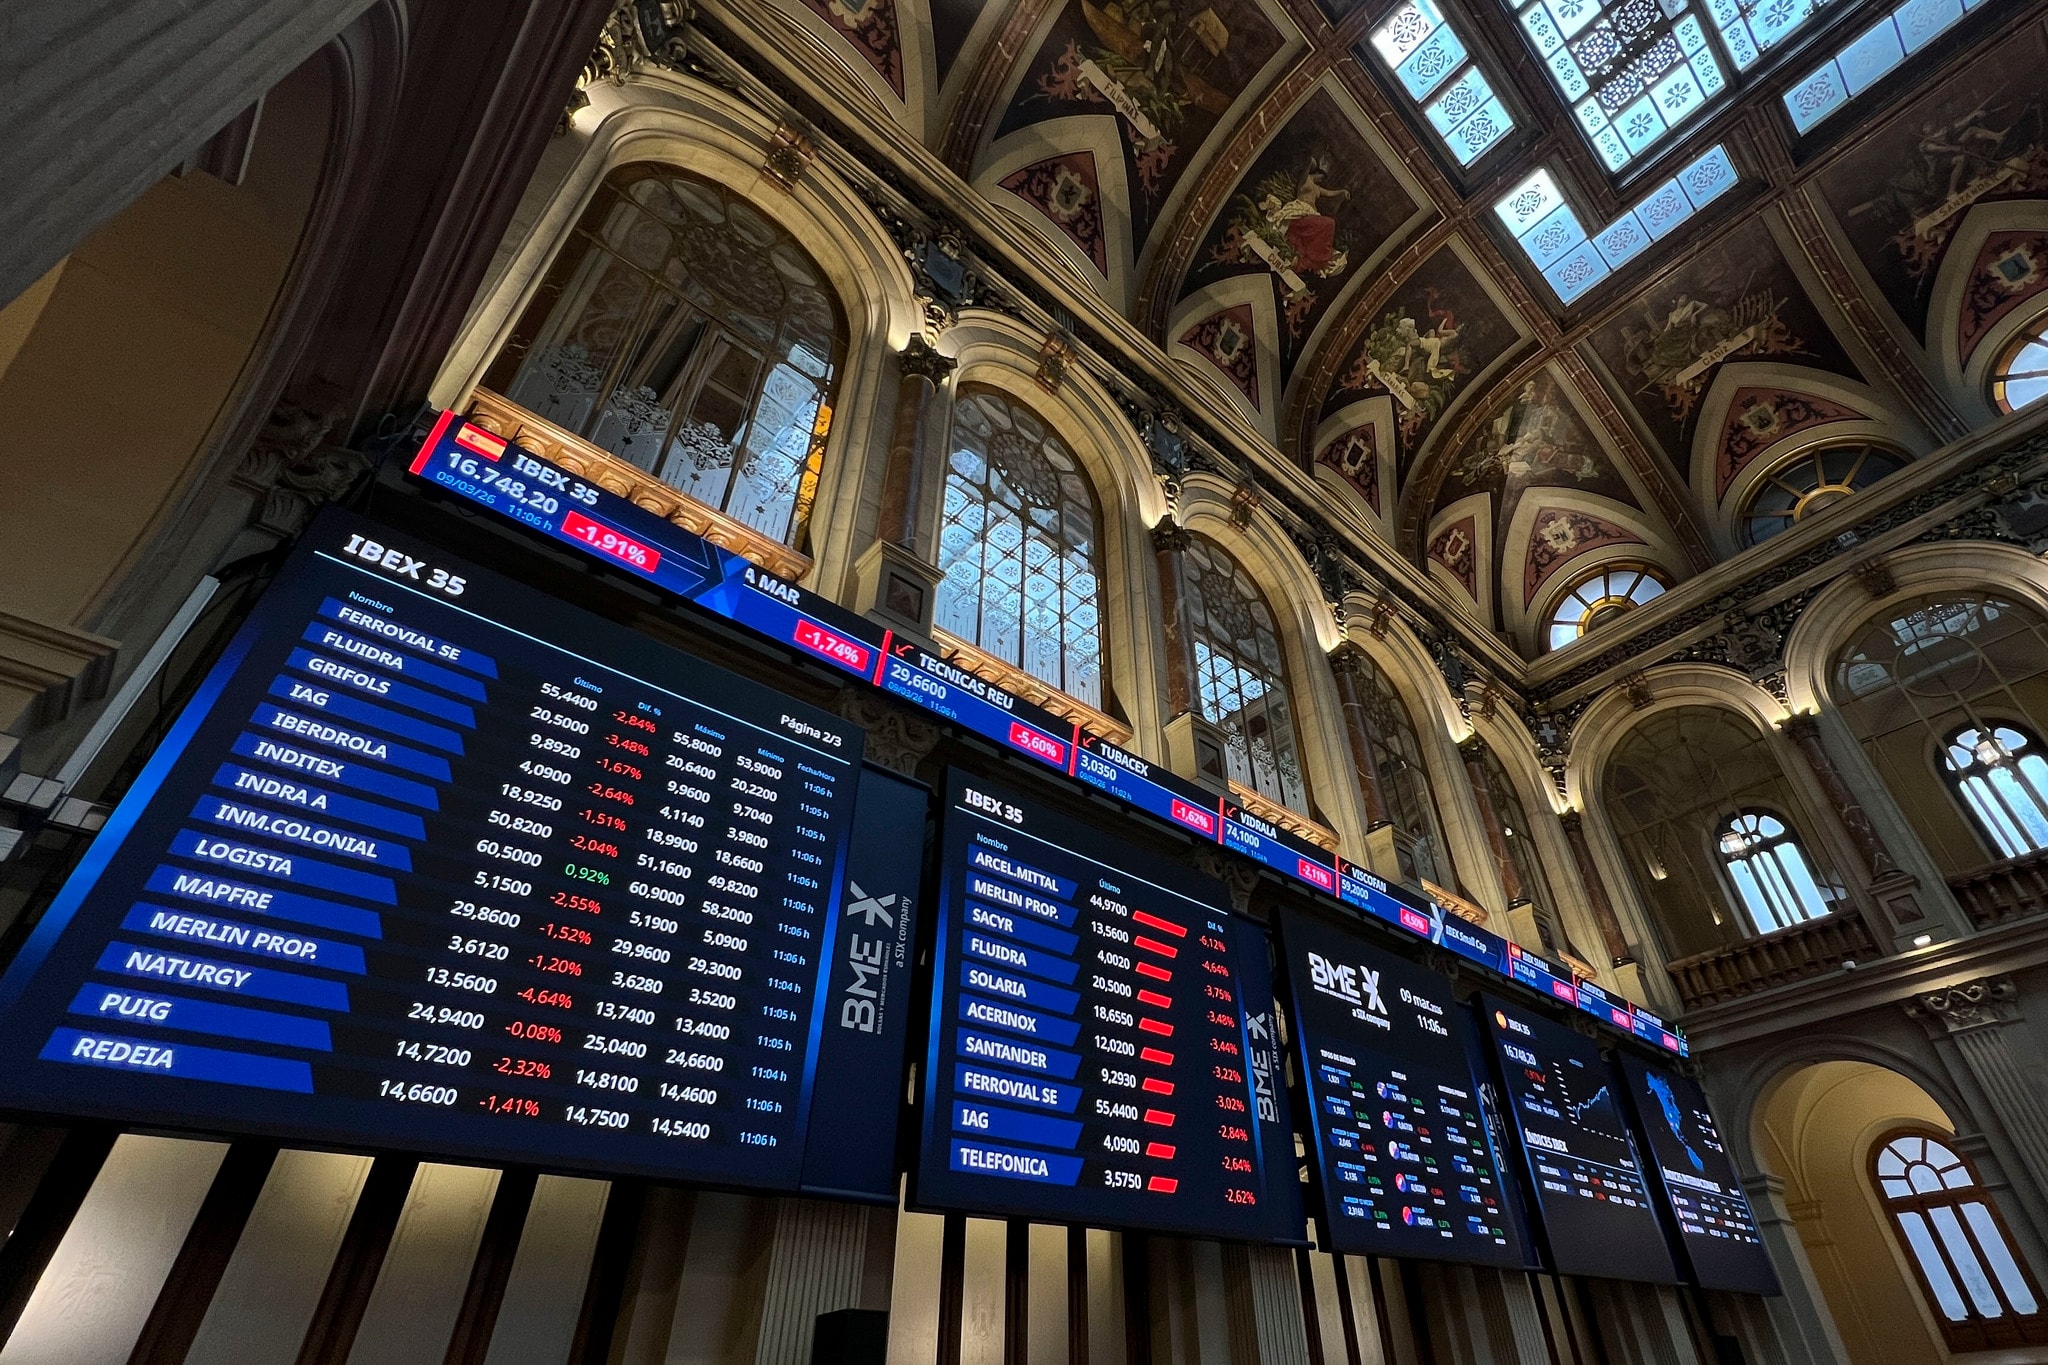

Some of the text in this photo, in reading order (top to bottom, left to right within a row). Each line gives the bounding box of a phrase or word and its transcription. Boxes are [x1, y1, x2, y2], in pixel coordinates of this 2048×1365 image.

[436, 470, 542, 529] 09/03/26 11:06
[447, 451, 559, 515] 16.748,20
[512, 453, 600, 506] IBEX 35
[343, 533, 467, 596] IBEX 35
[575, 522, 646, 567] -1,91%
[758, 574, 800, 605] MAR
[348, 590, 394, 614] Nombre
[573, 676, 603, 694] Último
[804, 629, 859, 664] -1,74%
[322, 631, 649, 757] FLUIDRA 20,5000 -3,48%
[337, 606, 722, 758] FERROVIAL SE 55,4400 -2,84% 55,8000
[888, 681, 924, 704] 09/03/26
[890, 664, 947, 700] 29,6600
[920, 652, 1014, 709] TECNICAS REU
[289, 683, 634, 806] IAG 4,0900 -2,64%
[307, 657, 711, 804] GRIFOLS 9,8920 -1,67% 9,9600
[780, 714, 842, 747] Página 2/3
[1016, 729, 1057, 758] -5,60%
[1100, 743, 1149, 776] TUBACEX
[253, 741, 618, 858] INDITEX 50,8200 -2,04%
[271, 712, 698, 854] IBERDROLA 18,9250 -1,51% 18,9900
[1081, 754, 1117, 781] 3,0350
[964, 787, 1023, 824] IBEX 35
[1175, 806, 1208, 829] -1,62%
[1226, 823, 1260, 848] 74,1000
[1240, 812, 1277, 840] VIDRALA
[214, 803, 679, 934] INM.COLONIAL 5,1500 -2,55% 5,1900
[234, 772, 685, 906] INDRA A 60,5000 0,92% 60,9000
[976, 832, 1009, 852] Nombre
[194, 838, 671, 964] LOGISTA 29,8600 -1,52% 29,9600
[974, 851, 1226, 953] ARCEL.MITTAL 44,9700 -6,12%
[1302, 864, 1327, 885] -2,11%
[1341, 880, 1368, 900] 59,2000
[1351, 867, 1386, 893] VISCOFAN
[172, 874, 582, 977] MAPFRE 3,6120 -1,20%
[894, 896, 912, 960] SIX company
[972, 907, 1232, 1002] SACYR 4,0020 -3,75%
[974, 879, 1229, 977] MERLIN PROP. 13,5600 -4,64%
[1475, 938, 1487, 954] Cap
[125, 951, 562, 1044] NATURGY 24,9400 -0,08%
[150, 912, 656, 1026] MERLIN PROP. 13,5600 -4,64% 13,7400
[841, 933, 882, 1032] BME
[971, 937, 1235, 1028] FLUIDRA 20,5000 -3,48%
[1400, 988, 1412, 1004] 09
[99, 993, 639, 1093] PUIG 14,7200 -2,32% 14,8100
[966, 1002, 1242, 1083] ACERINOX 12,0200 -3,22%
[969, 969, 1238, 1055] SOLARIA 18,6550 -3,44%
[1523, 1023, 1531, 1036] 35
[71, 1037, 630, 1129] REDEIA 14,6600 -1,41% 14,7500
[965, 1036, 1245, 1113] SANTANDER 9,2930 -3,02%
[1503, 1043, 1536, 1066] 16.748,20
[964, 1071, 1249, 1142] FERROVIAL SE 55,4400 -2,84%
[961, 1108, 1252, 1173] IAG 4,0900 -2,64%
[959, 1147, 1256, 1205] TELEFONICA 3,5750 -2,62%
